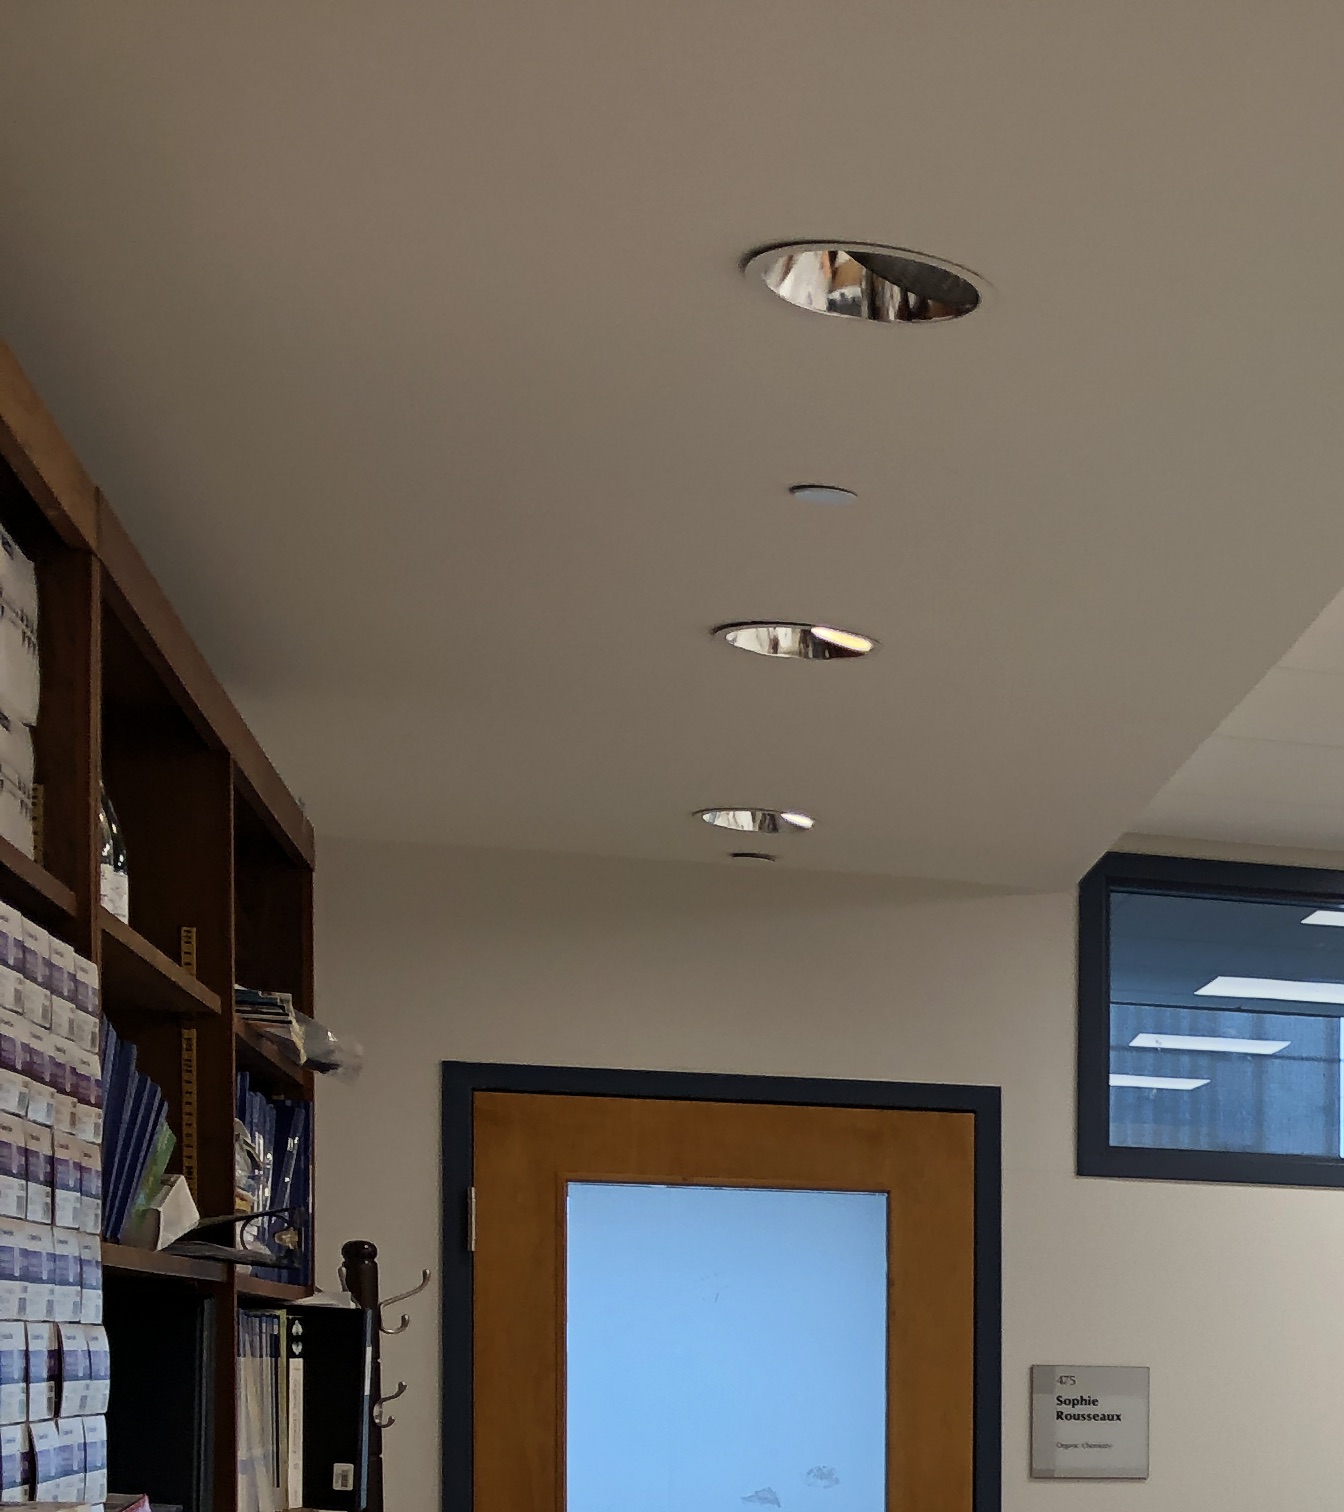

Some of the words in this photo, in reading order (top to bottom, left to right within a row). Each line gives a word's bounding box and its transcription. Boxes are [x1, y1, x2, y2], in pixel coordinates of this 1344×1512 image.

[1056, 1375, 1076, 1386] 475
[1056, 1395, 1099, 1408] Sophie
[1056, 1411, 1122, 1422] Rousseaux
